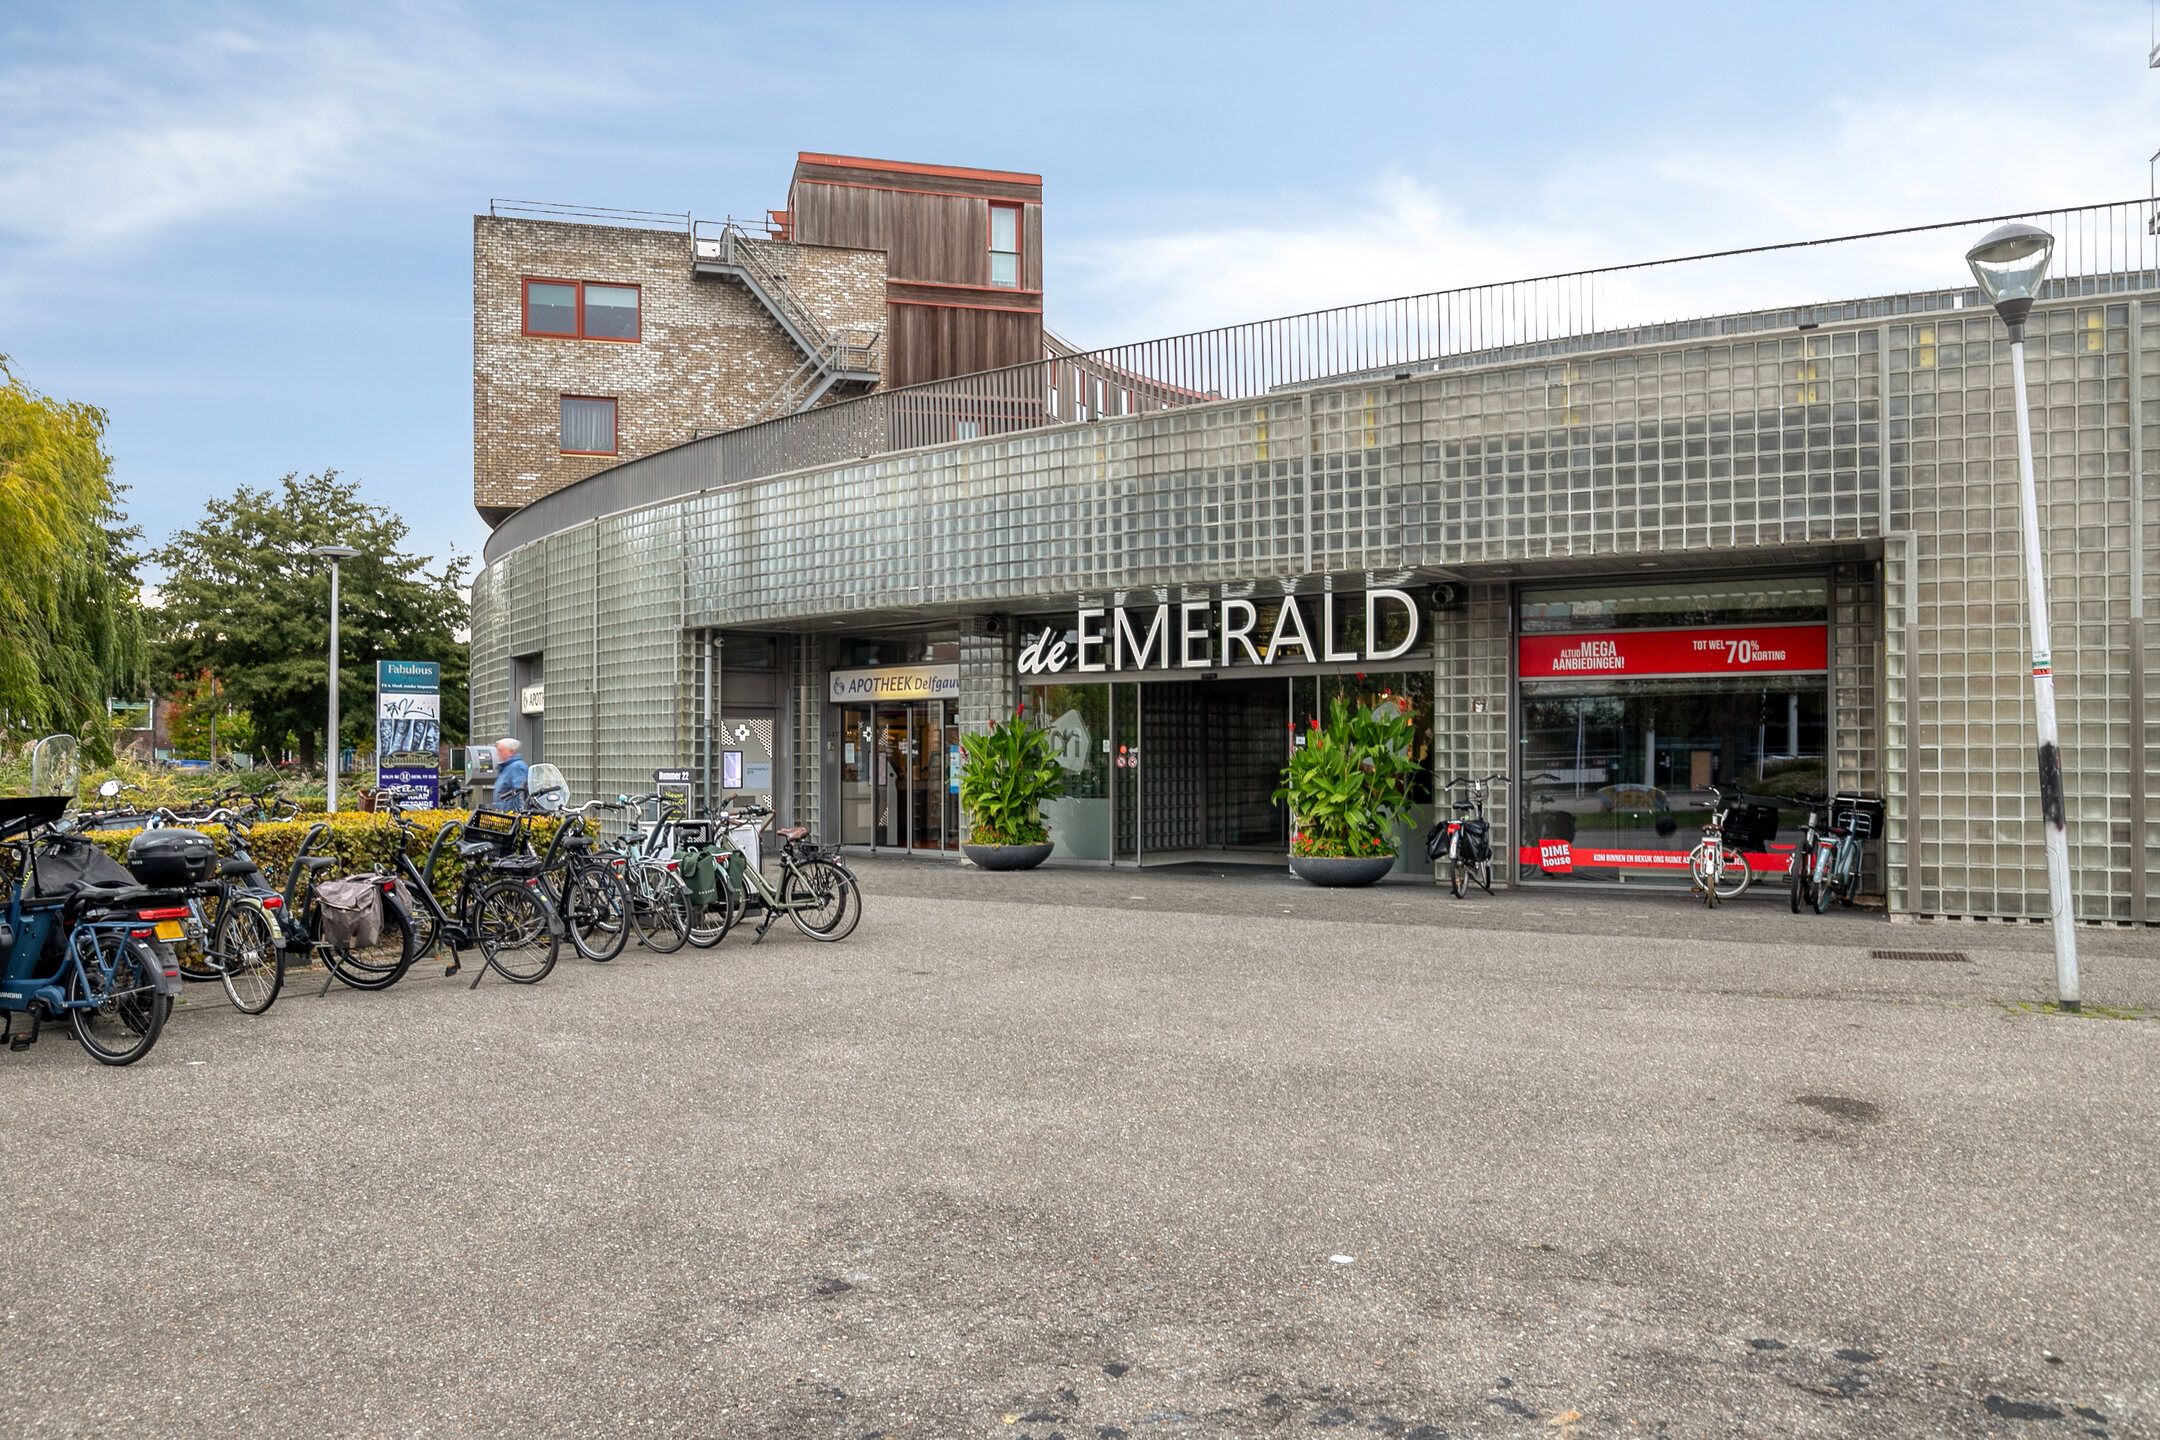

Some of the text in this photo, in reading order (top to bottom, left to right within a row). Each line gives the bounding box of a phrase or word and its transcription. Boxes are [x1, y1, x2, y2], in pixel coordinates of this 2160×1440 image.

[1017, 589, 1419, 675] de EMERALD
[1560, 641, 1617, 658] ALTIJD MEGA
[1692, 640, 1707, 650] TOT
[1708, 640, 1726, 650] WEL
[1752, 651, 1786, 661] KORTING
[388, 664, 433, 675] Fabulous
[1552, 656, 1625, 670] AANBIEDINGEN!
[848, 676, 912, 693] APOTHEEK
[659, 771, 689, 780] Nummer 22
[1541, 844, 1570, 858] DIME
[1542, 856, 1571, 867] house
[1593, 854, 1606, 862] KOM
[1626, 855, 1634, 863] EN
